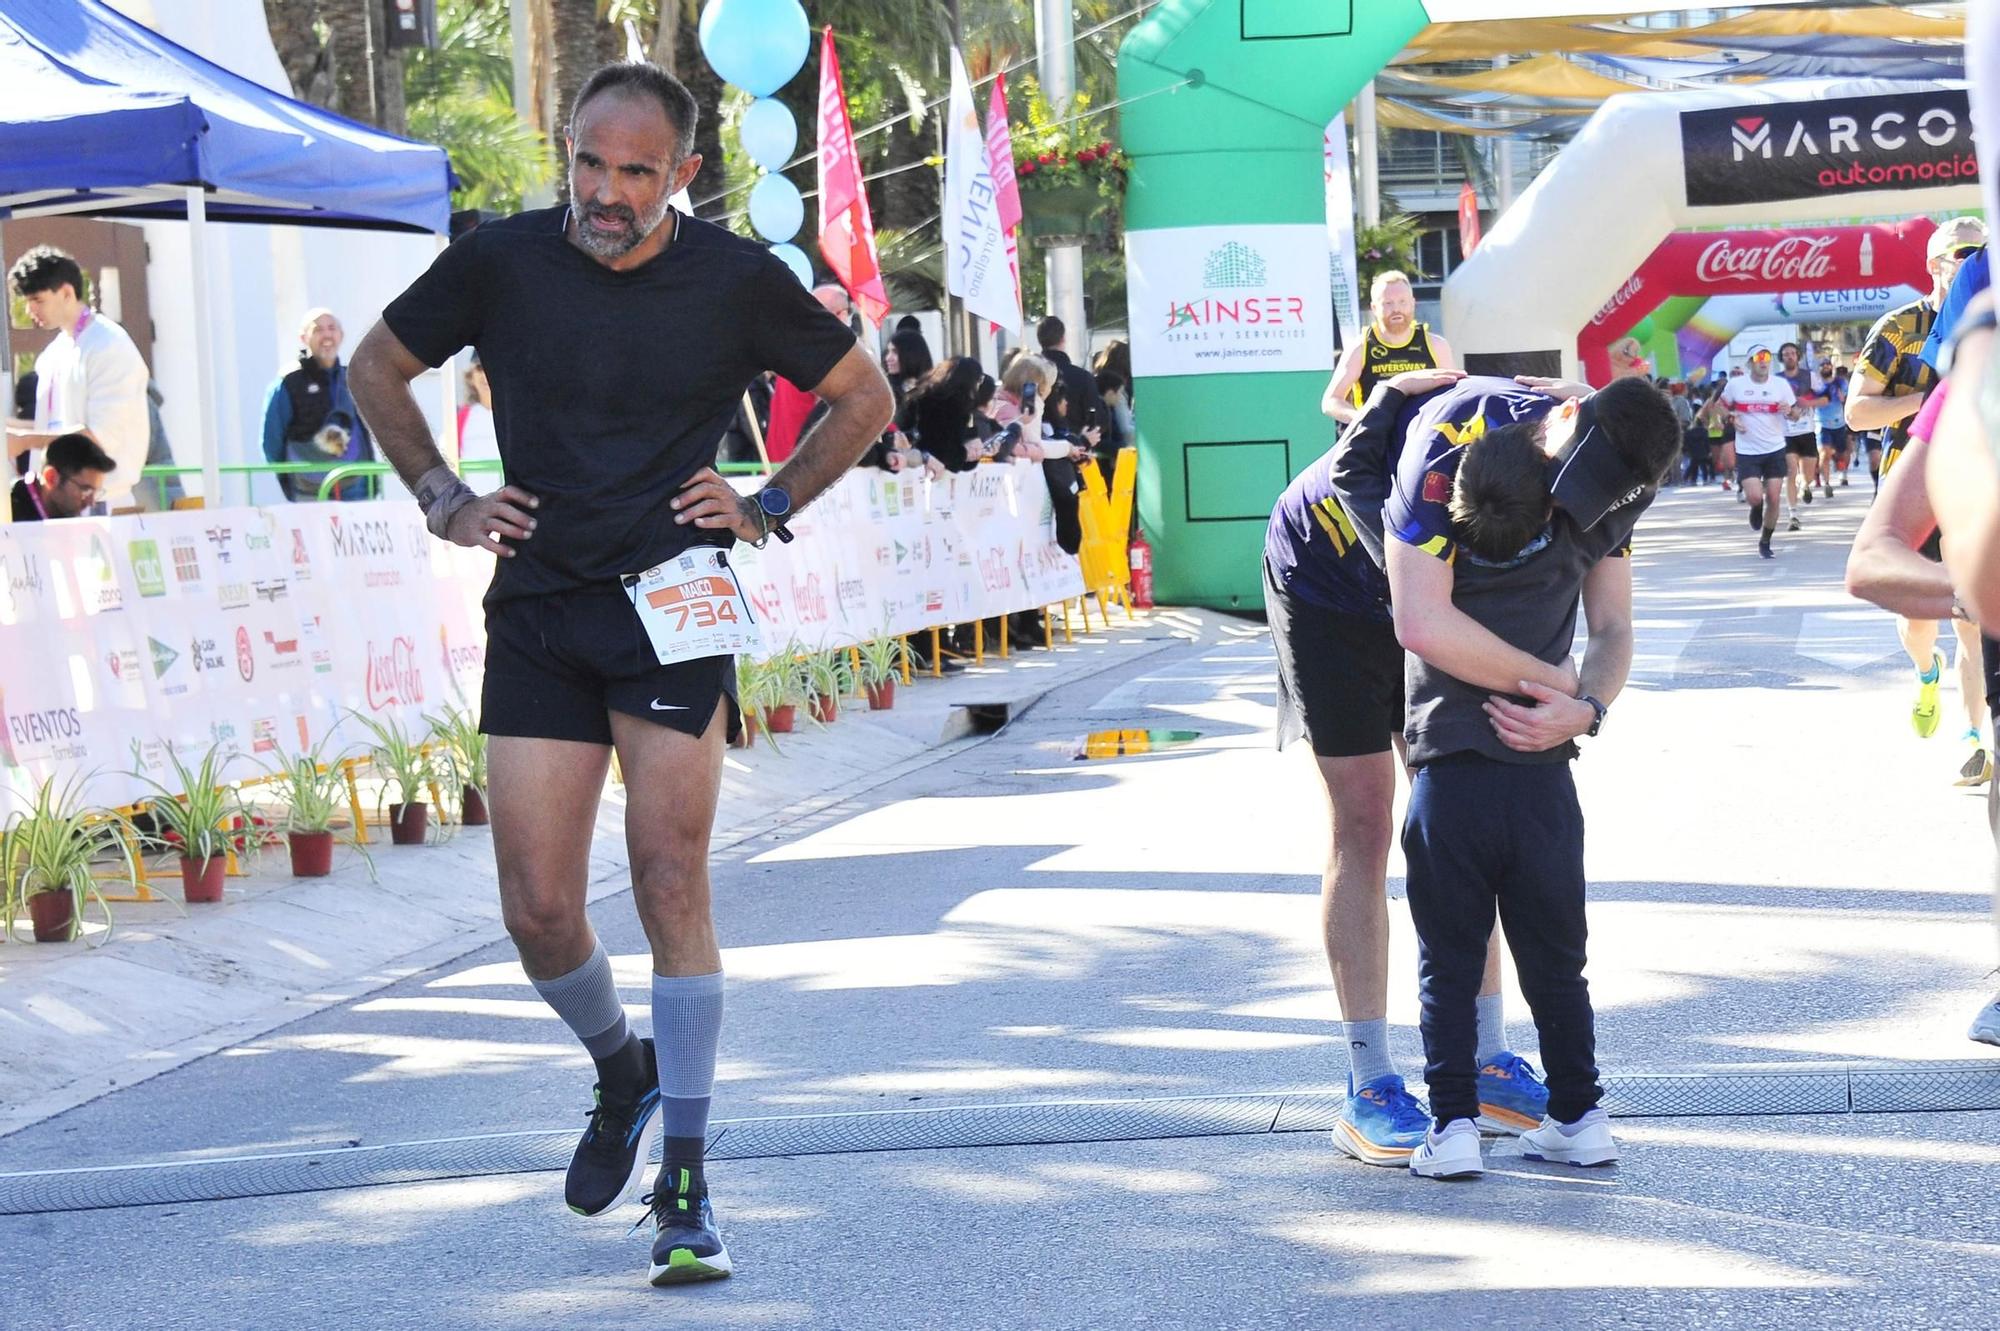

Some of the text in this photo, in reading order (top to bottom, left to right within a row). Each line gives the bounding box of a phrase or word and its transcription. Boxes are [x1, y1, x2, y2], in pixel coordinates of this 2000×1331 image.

[1696, 236, 1838, 282] Coca-Cola
[1798, 286, 1890, 304] EVENTOS
[1168, 297, 1304, 328] JAINSER
[1838, 304, 1885, 312] Torrellano
[1168, 332, 1208, 342] OBRAS
[1235, 329, 1306, 340] SERVICIOS
[1195, 349, 1282, 360] www.jainser.com
[1372, 363, 1426, 374] RIVERSWAY
[330, 516, 395, 557] MARCOS
[664, 600, 737, 632] 734
[10, 707, 81, 745] EVENTOS
